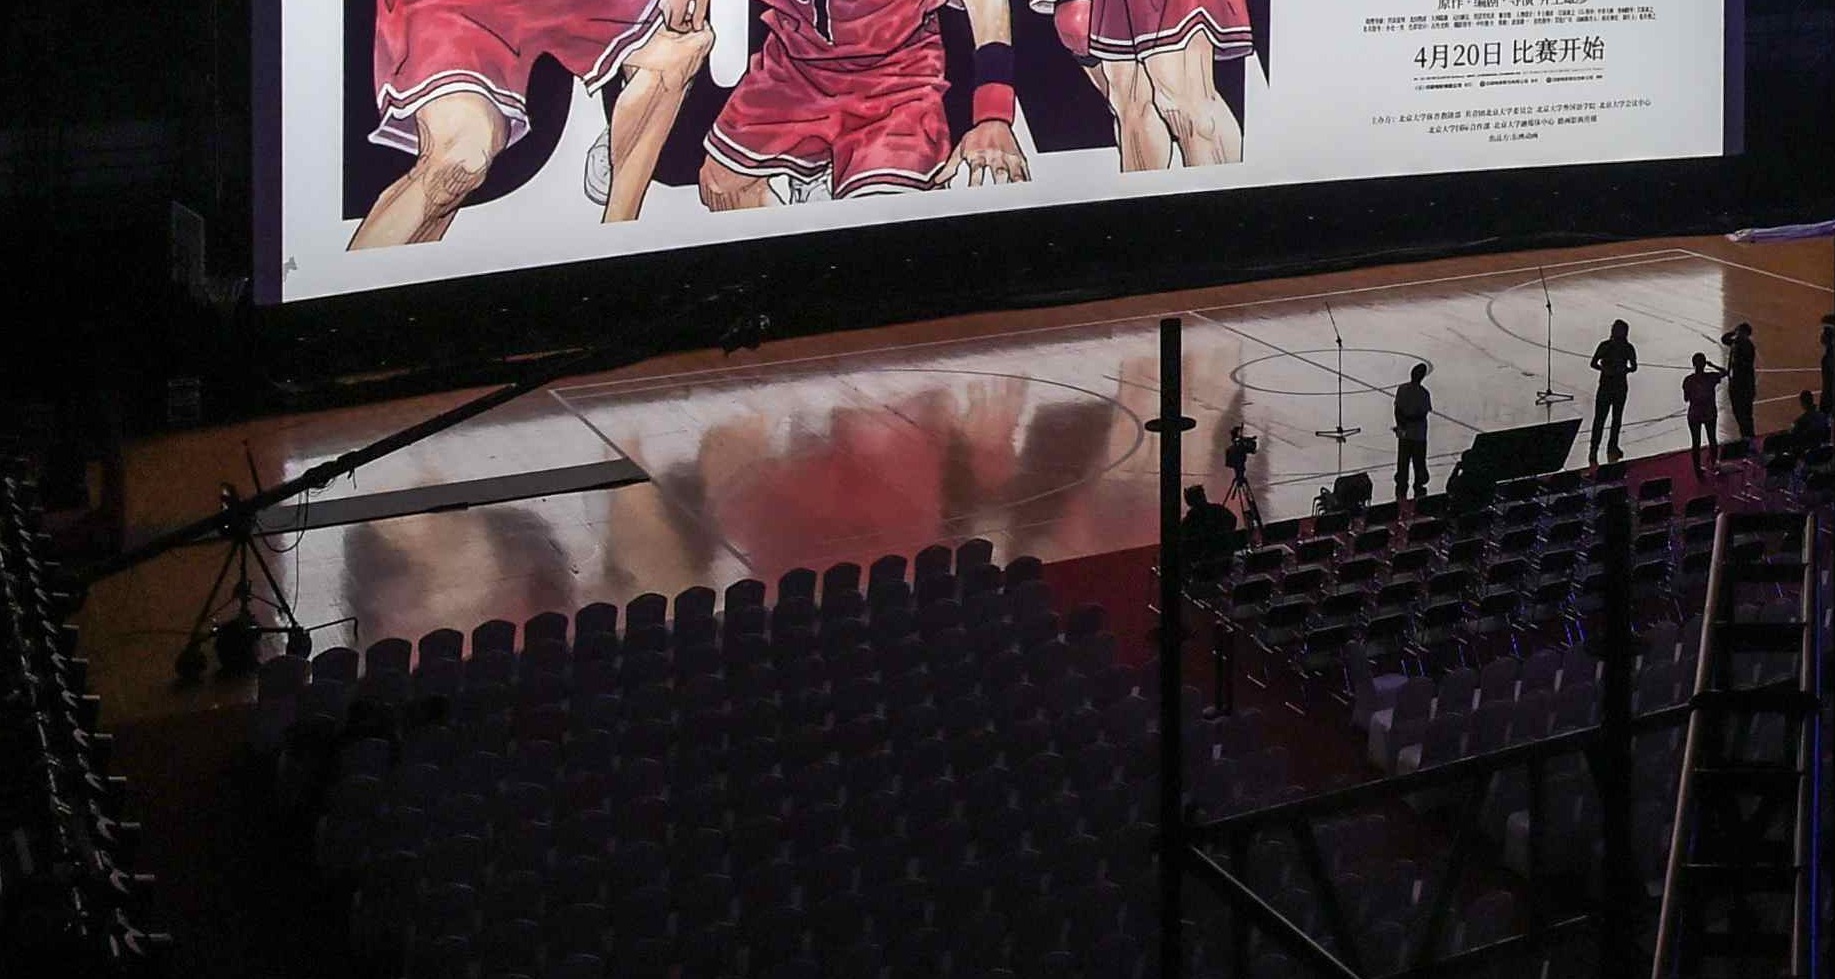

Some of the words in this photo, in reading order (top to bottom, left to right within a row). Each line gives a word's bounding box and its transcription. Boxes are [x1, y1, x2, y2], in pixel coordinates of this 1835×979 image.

[1413, 42, 1501, 69] 4月20日
[1512, 35, 1605, 64] 比赛开始
